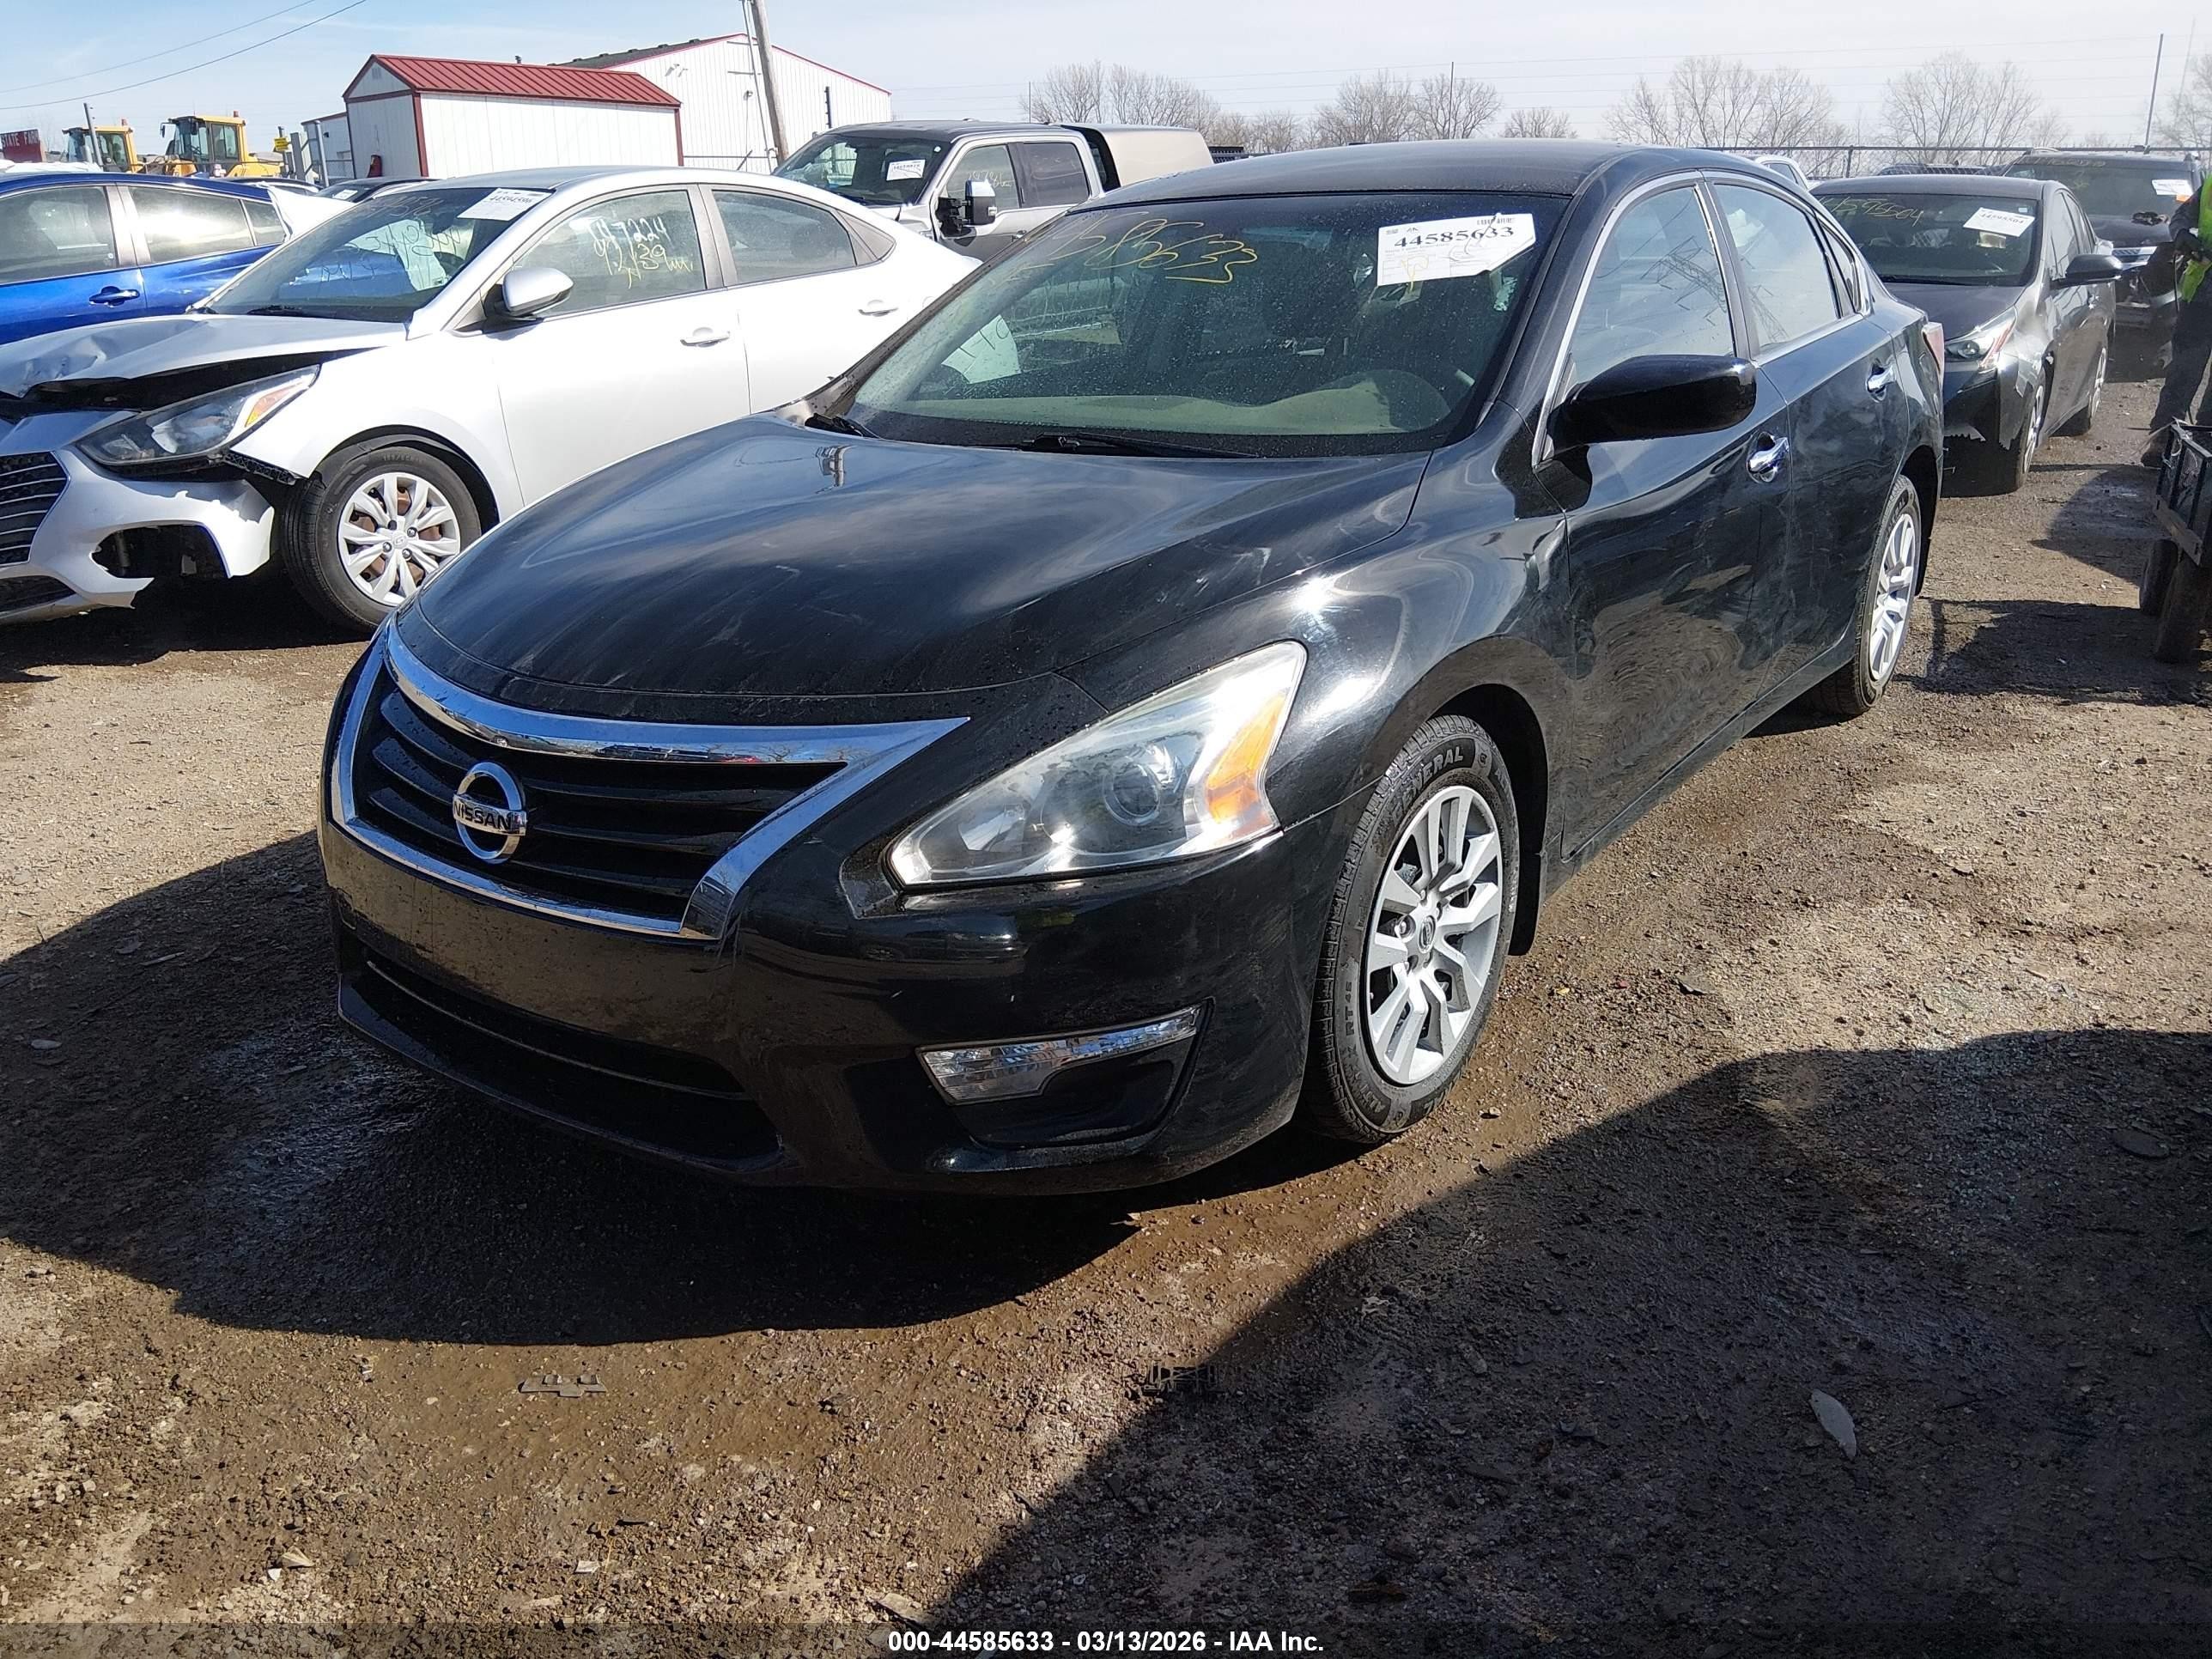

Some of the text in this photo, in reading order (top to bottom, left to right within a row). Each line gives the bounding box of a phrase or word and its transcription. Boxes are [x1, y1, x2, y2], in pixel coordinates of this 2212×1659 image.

[1, 133, 21, 148] STATE
[1394, 226, 1515, 248] 44585633
[453, 800, 512, 830] NISSAN
